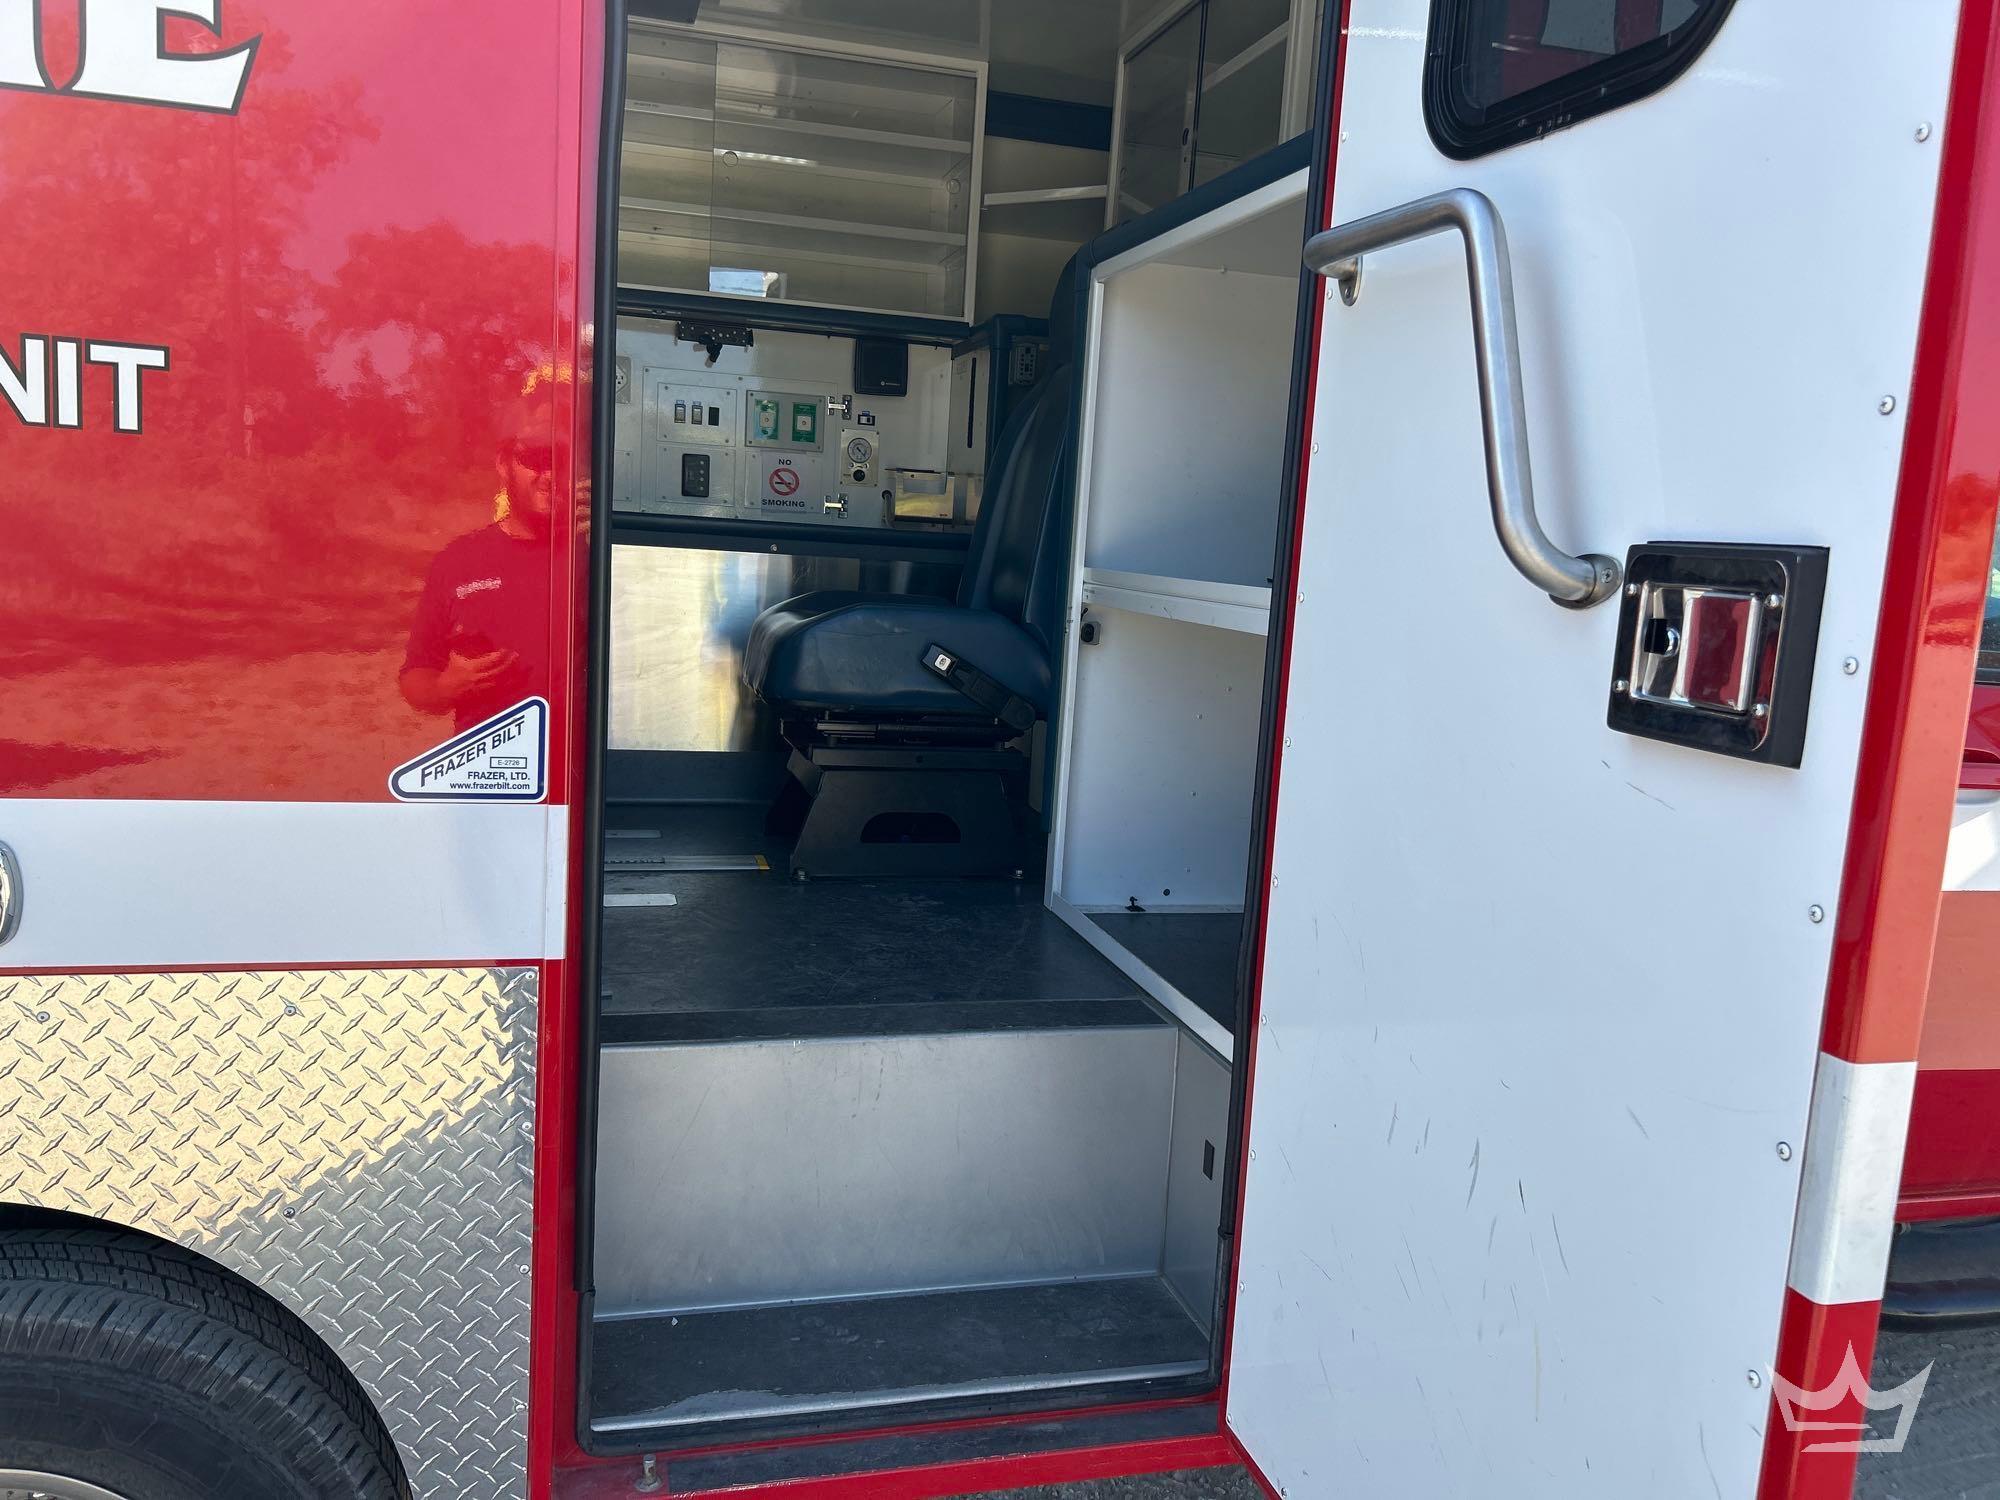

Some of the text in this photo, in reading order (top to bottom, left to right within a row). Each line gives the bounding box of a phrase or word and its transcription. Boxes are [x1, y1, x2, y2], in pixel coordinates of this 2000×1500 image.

[761, 499, 805, 508] SMOKING
[420, 720, 525, 787] FRAZER BILT
[467, 771, 531, 781] FRAZER, LTD.
[449, 781, 530, 790] www.frazerbilt.com
